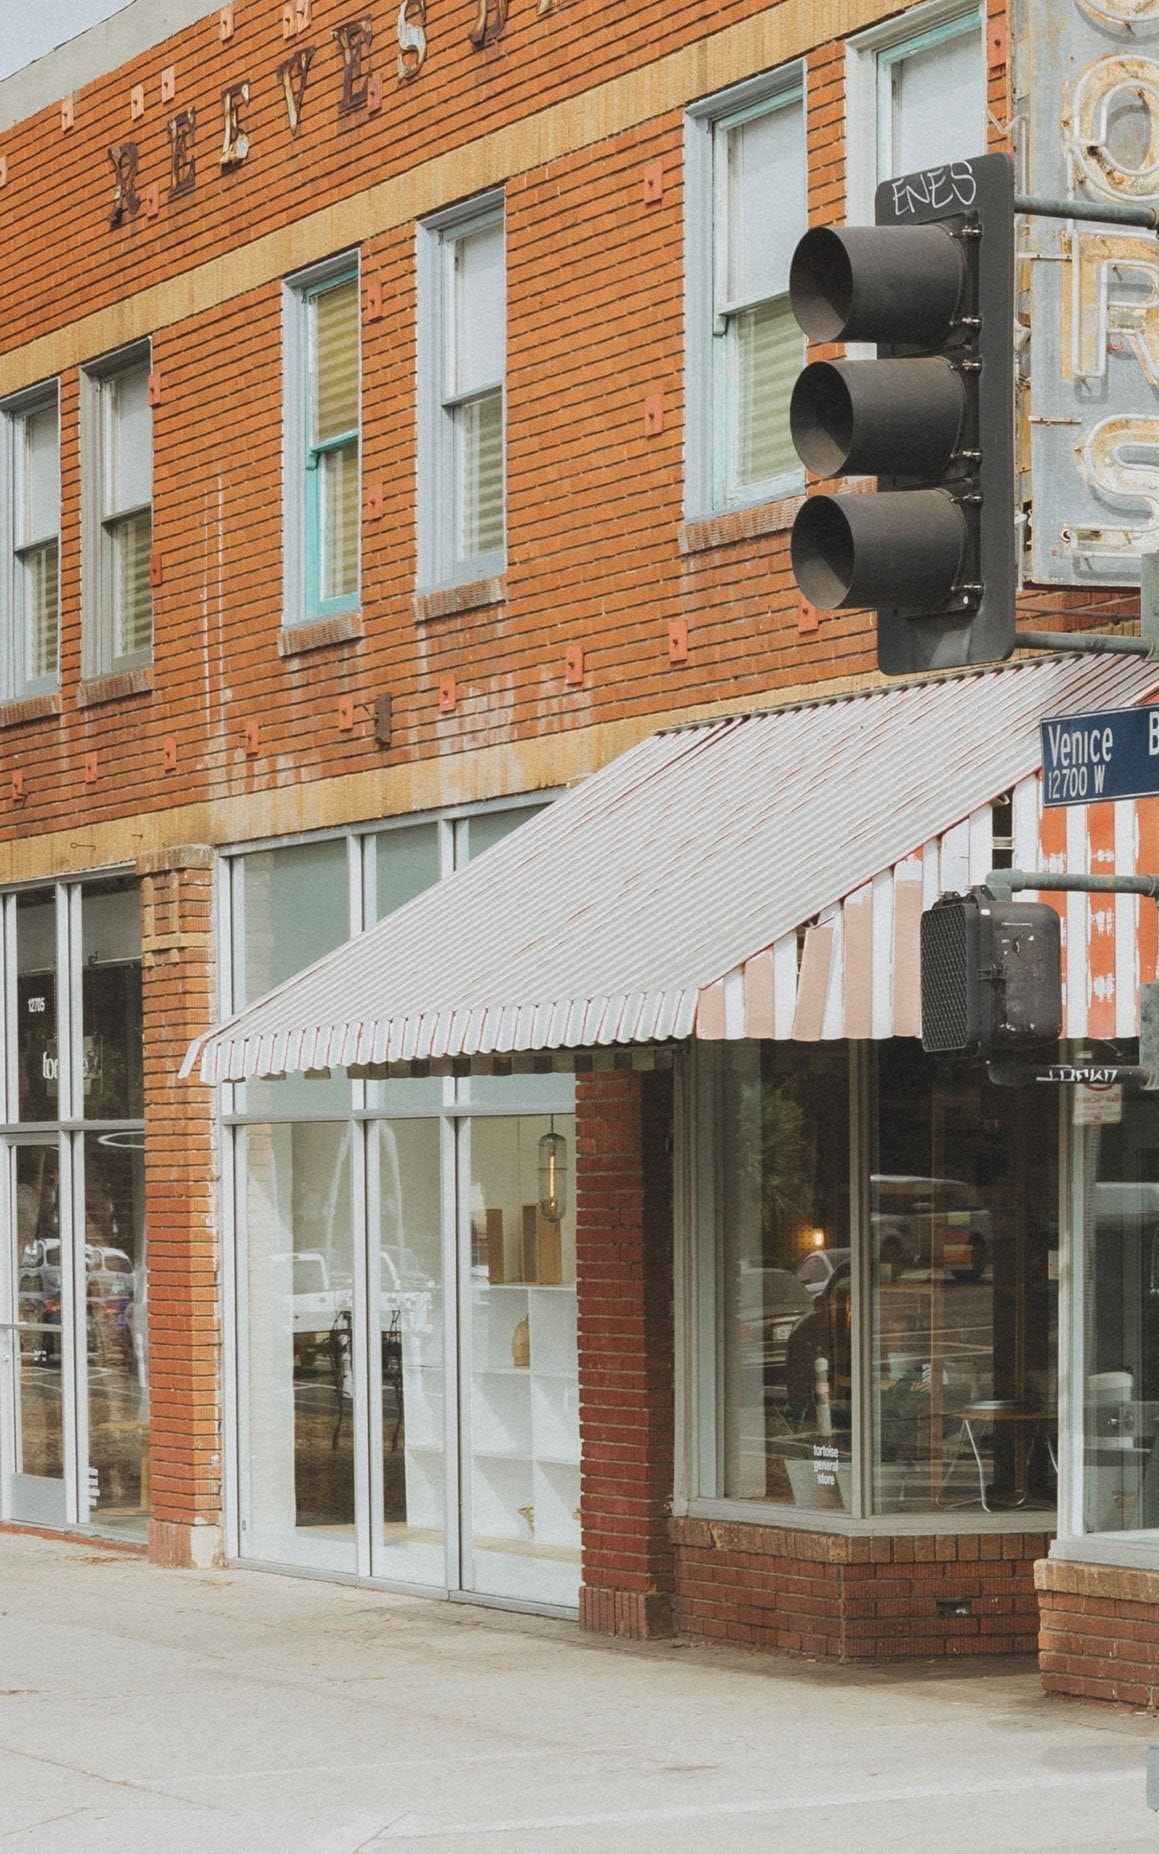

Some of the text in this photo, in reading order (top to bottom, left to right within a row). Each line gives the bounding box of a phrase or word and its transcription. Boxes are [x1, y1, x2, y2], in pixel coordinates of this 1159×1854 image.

[892, 160, 976, 215] ENES
[1048, 724, 1114, 768] Venice
[1048, 764, 1106, 799] 12700 W
[814, 1444, 839, 1458] tortoise
[813, 1459, 839, 1473] general
[817, 1472, 835, 1485] store
